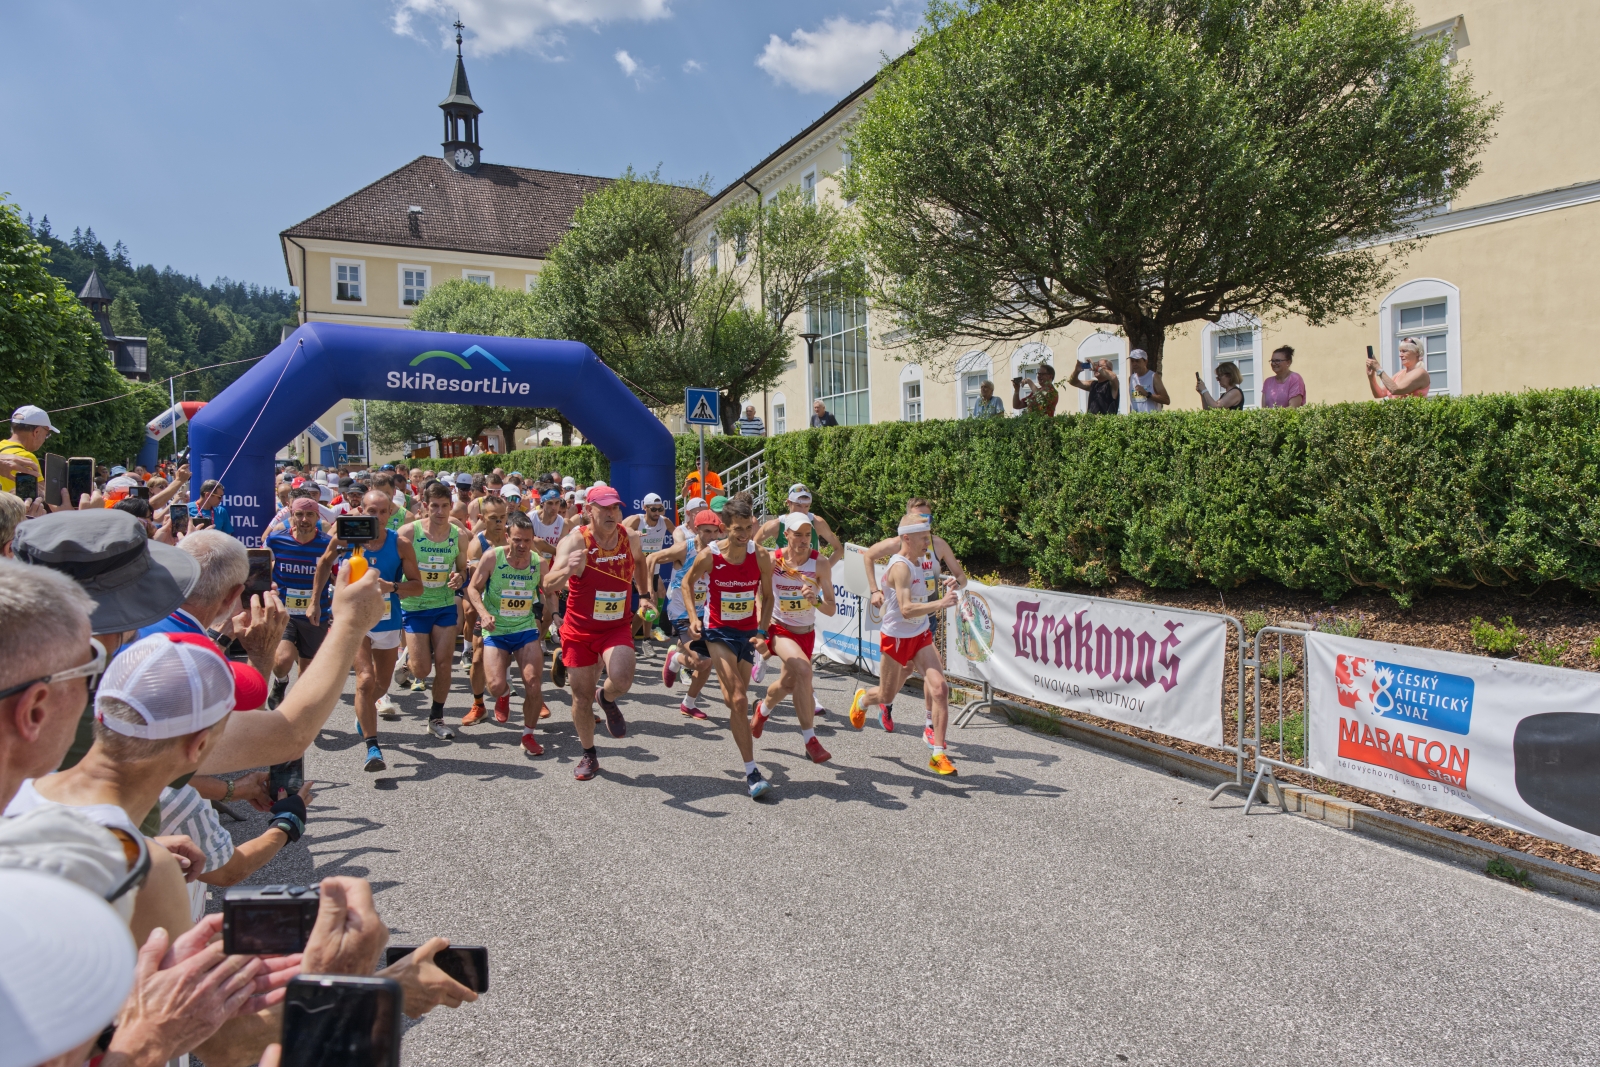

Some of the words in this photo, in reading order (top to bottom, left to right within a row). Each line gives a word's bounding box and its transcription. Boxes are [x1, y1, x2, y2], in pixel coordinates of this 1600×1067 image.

[386, 371, 531, 395] SkiResortLive
[219, 494, 260, 507] HOOL
[280, 562, 317, 575] FRANC
[426, 572, 438, 580] 33
[501, 573, 533, 581] SLOVENIJA
[295, 598, 308, 607] 81
[507, 599, 526, 608] 609
[605, 602, 618, 611] 26
[728, 602, 748, 611] 425
[789, 600, 802, 609] 31
[1011, 600, 1185, 693] Krakonoš
[1396, 669, 1439, 691] ČESKÝ
[1033, 674, 1081, 698] PIVOVAR
[1087, 687, 1146, 713] TRUTNOV
[1395, 687, 1469, 713] ATLETICKÝ
[1396, 703, 1429, 721] SVAZ
[1338, 717, 1470, 773] MARATON
[1402, 776, 1438, 792] jednota
[1428, 768, 1462, 786] stav
